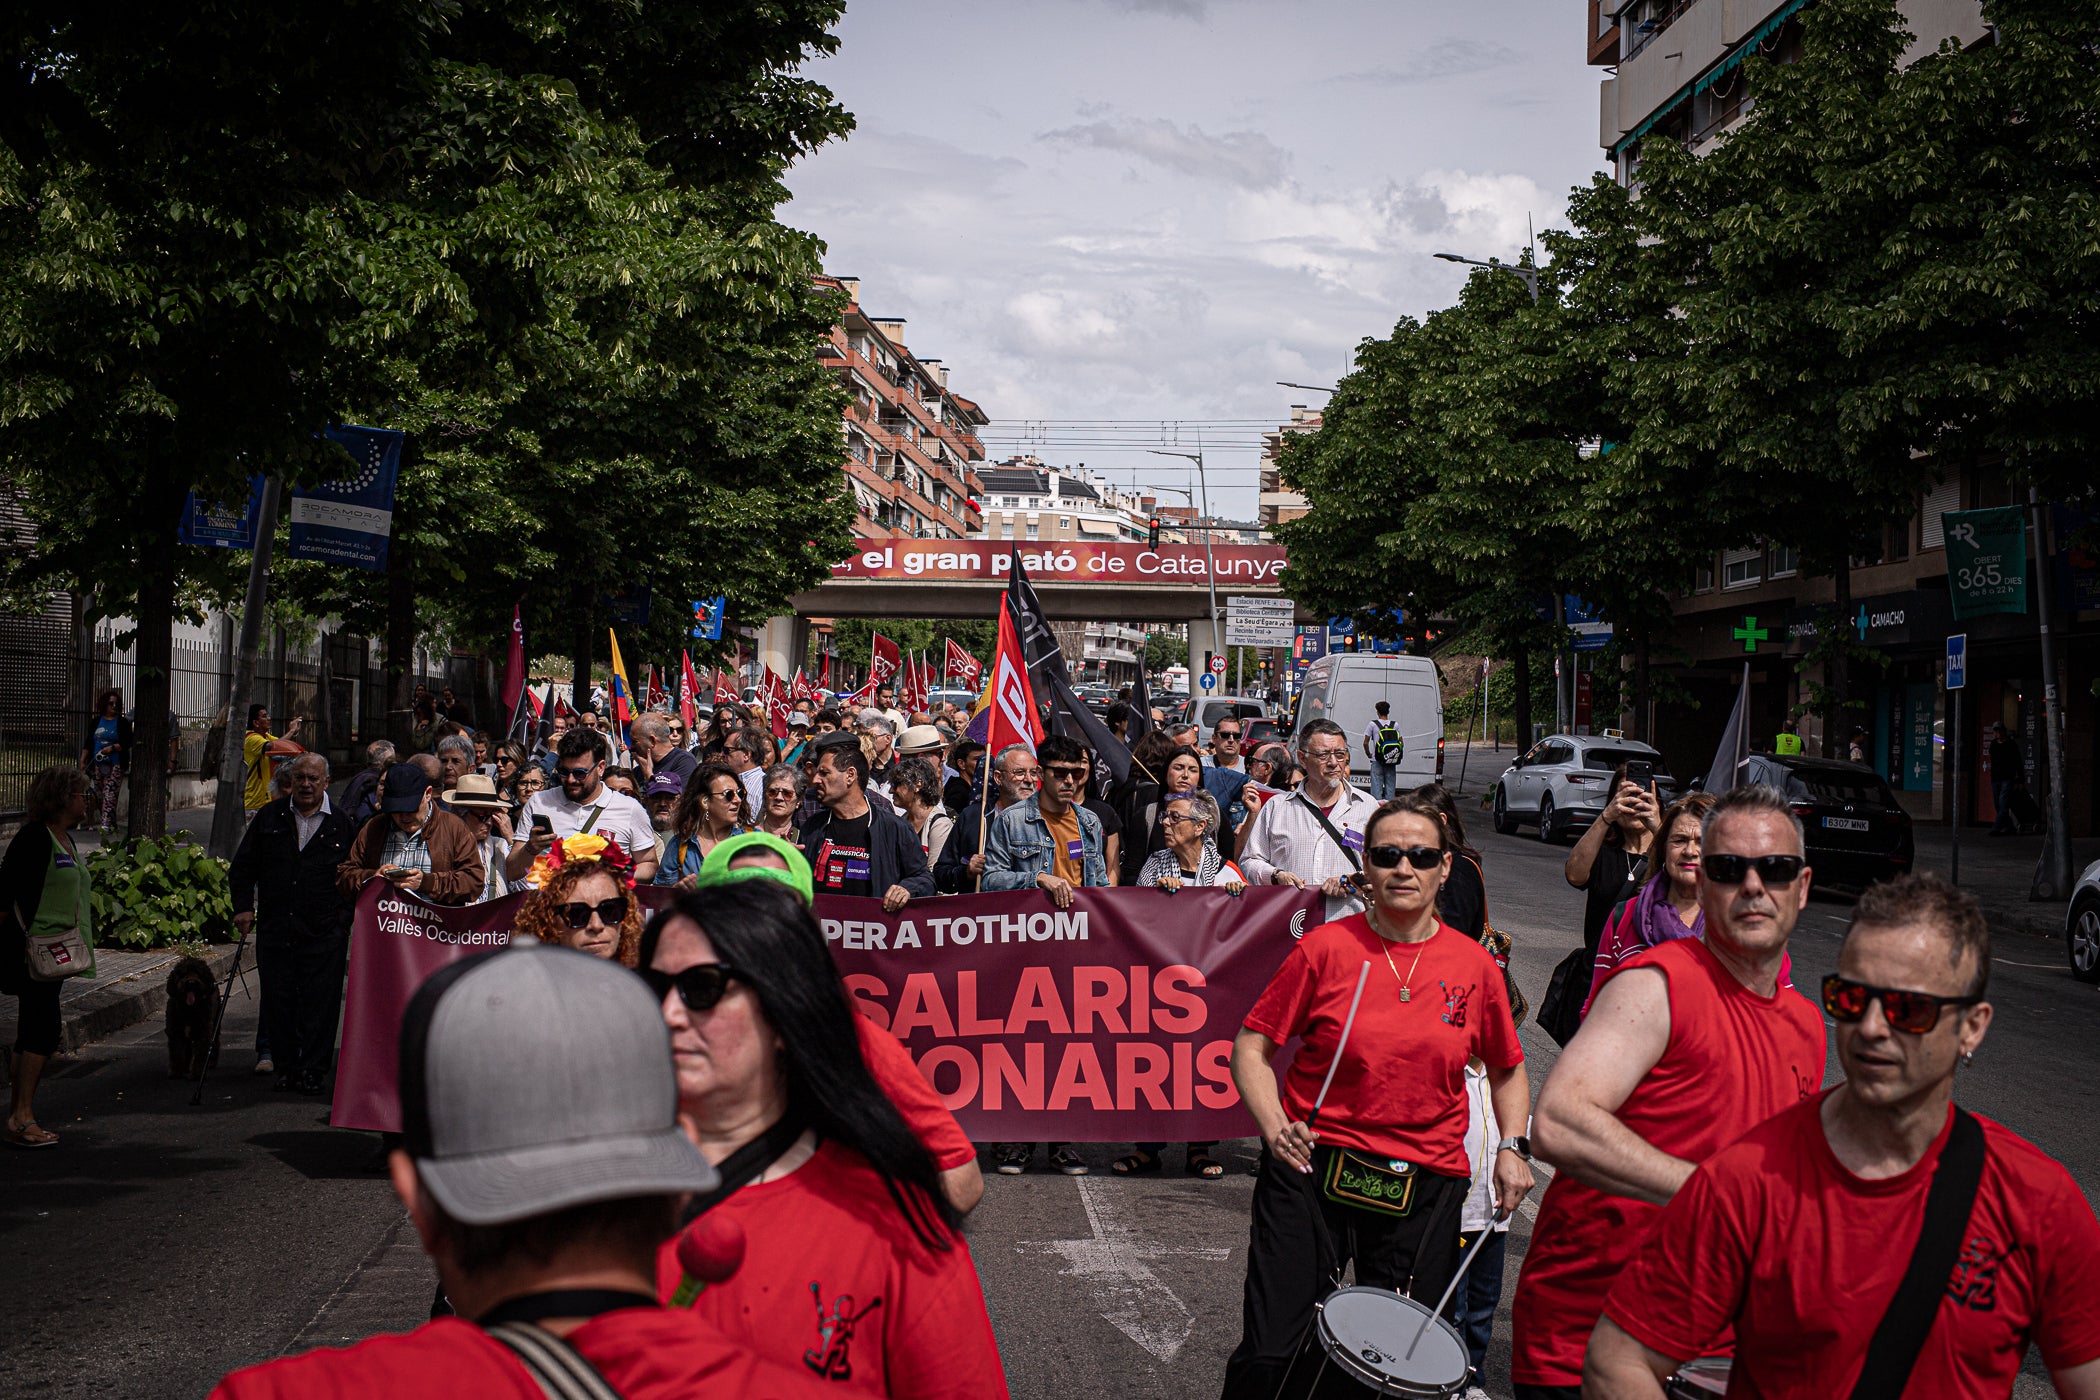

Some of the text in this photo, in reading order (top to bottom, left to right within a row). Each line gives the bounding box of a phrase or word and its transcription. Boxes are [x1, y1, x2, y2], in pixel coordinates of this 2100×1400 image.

[301, 503, 382, 520] ROCAMORA
[299, 544, 376, 561] rocamoradental.com
[1973, 555, 2002, 565] OBERT
[862, 548, 893, 568] el
[903, 552, 981, 575] gran
[1087, 551, 1126, 573] de
[1135, 552, 1288, 580] Cataunya
[1957, 564, 2023, 590] 365 DIES
[1969, 589, 1980, 597] de
[1871, 610, 1905, 628] CAMACHO
[948, 658, 977, 677] PSC
[1948, 654, 1963, 671] TAXI
[1915, 736, 1927, 747] TOTS
[1828, 818, 1867, 830] 6307 MNK
[830, 849, 870, 859] DOMESTICATS
[377, 915, 511, 945] Vallès Occidental
[820, 911, 1089, 950] PER A TOTHOM
[842, 964, 1207, 1039] SALARIS
[905, 1039, 1242, 1111] ONARIS
